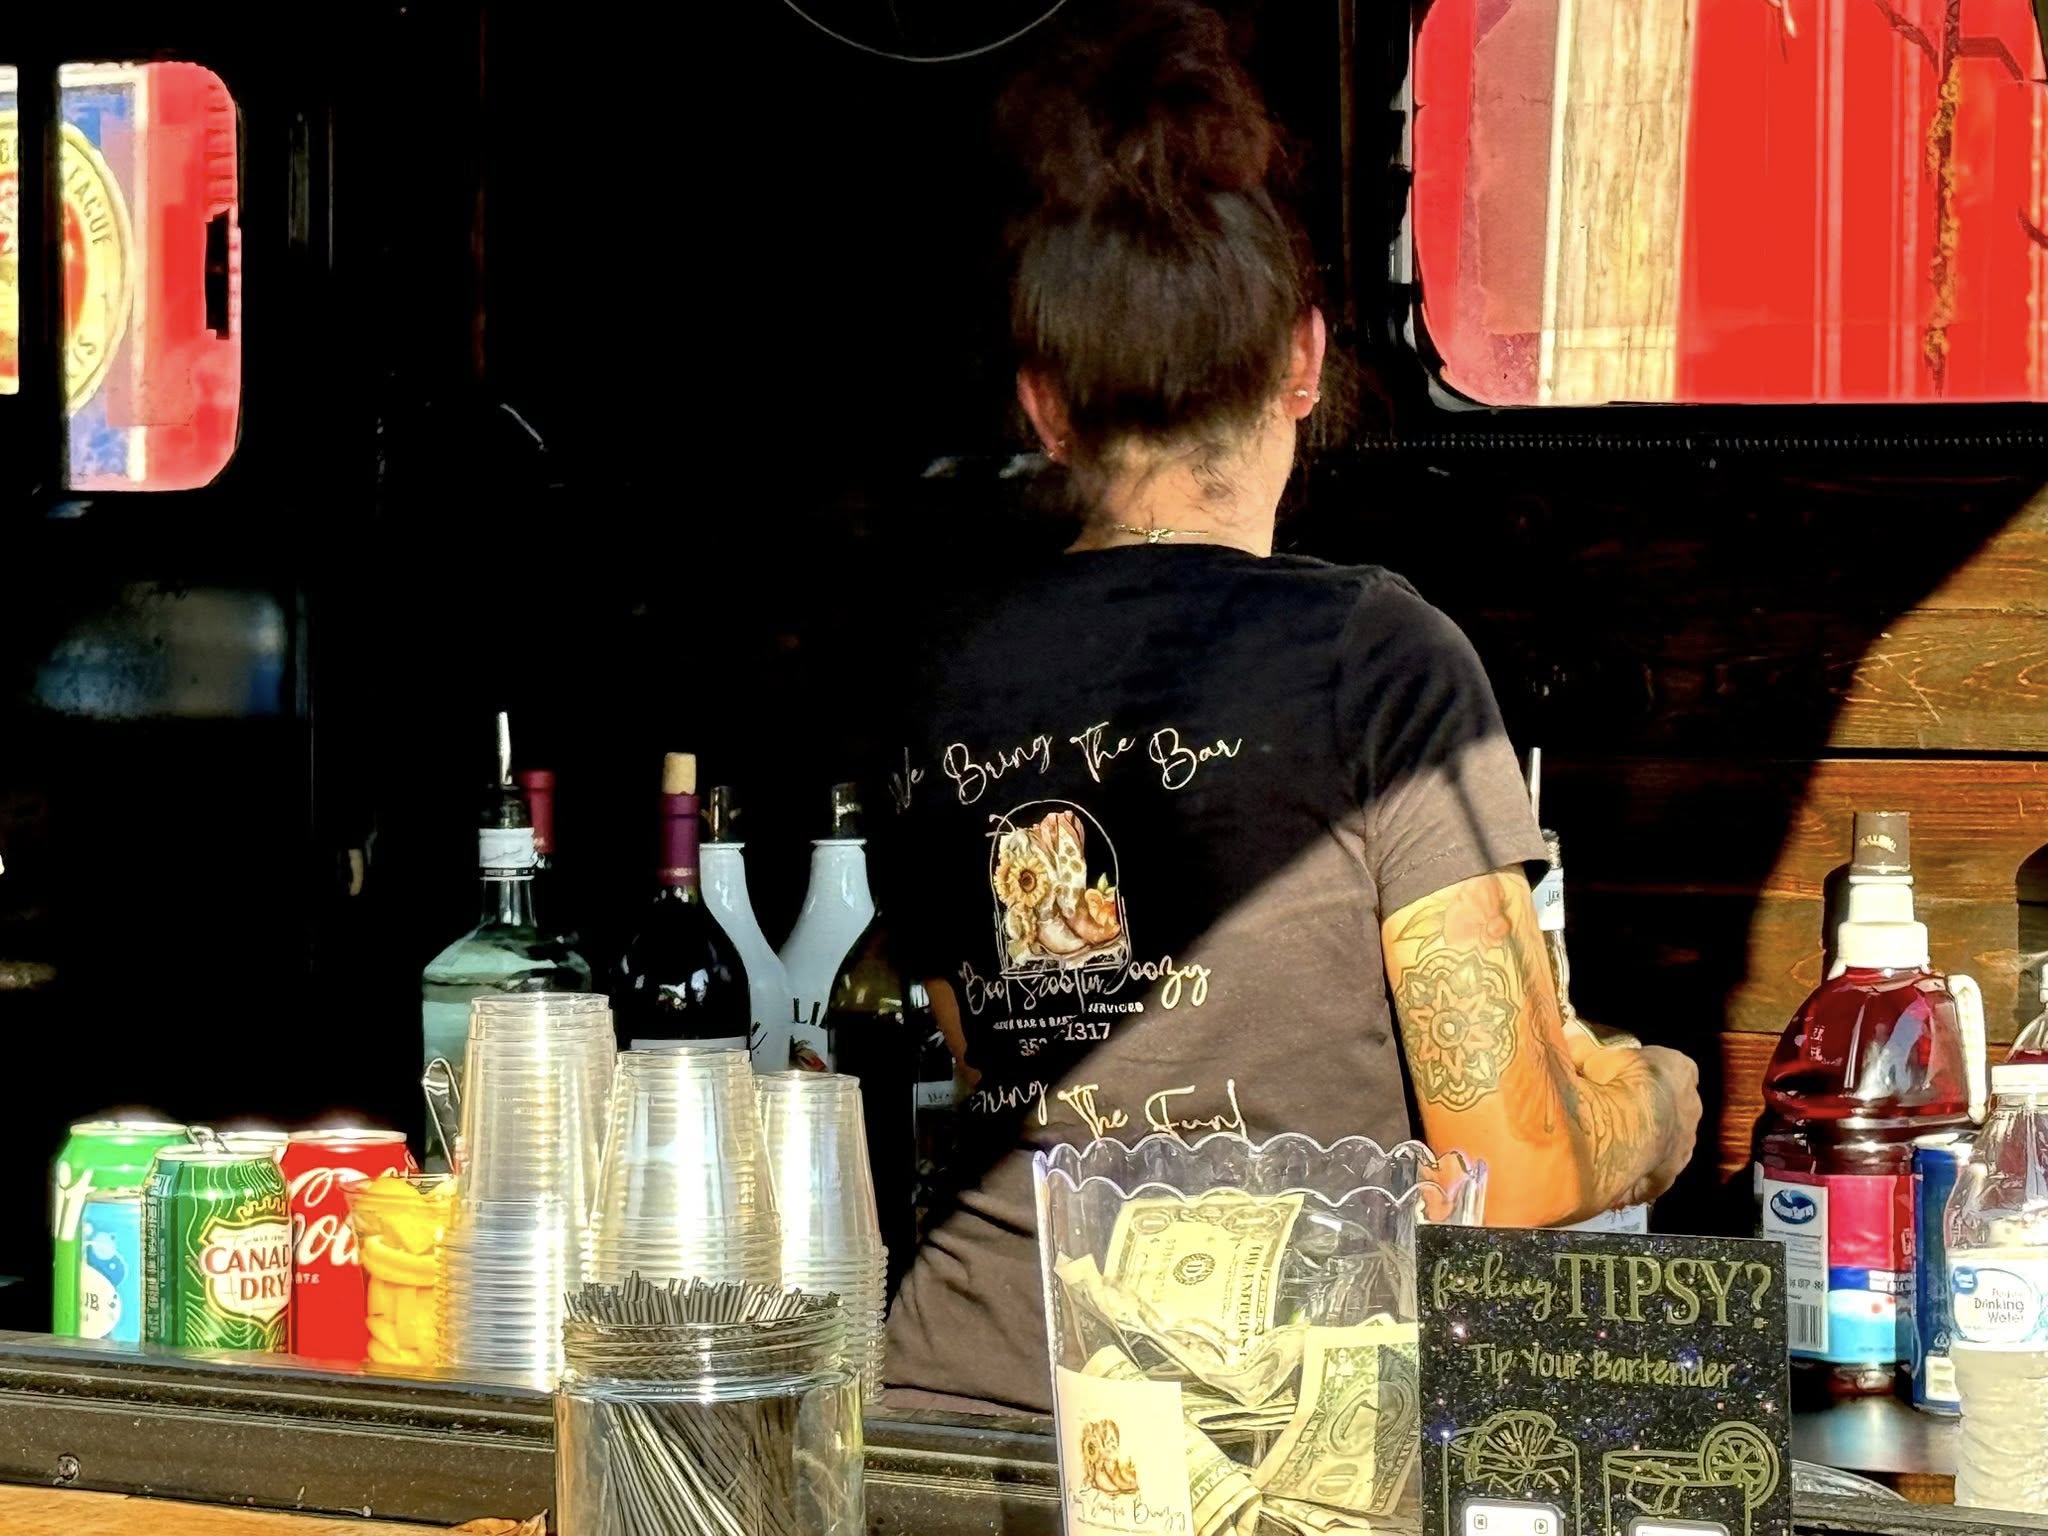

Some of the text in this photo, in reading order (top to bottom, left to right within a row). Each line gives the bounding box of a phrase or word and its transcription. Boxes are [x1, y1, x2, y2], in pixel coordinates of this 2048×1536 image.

[943, 734, 1053, 805] Bring
[1070, 721, 1136, 783] The
[1149, 727, 1242, 789] Bar
[1104, 954, 1212, 1010] oozy
[1057, 1083, 1129, 1141] The
[240, 1271, 289, 1301] DRY
[1432, 1251, 1773, 1329] feeling TIPSY?
[1974, 1297, 2025, 1313] Drinking
[1466, 1342, 1738, 1390] Tip Your Bartender
